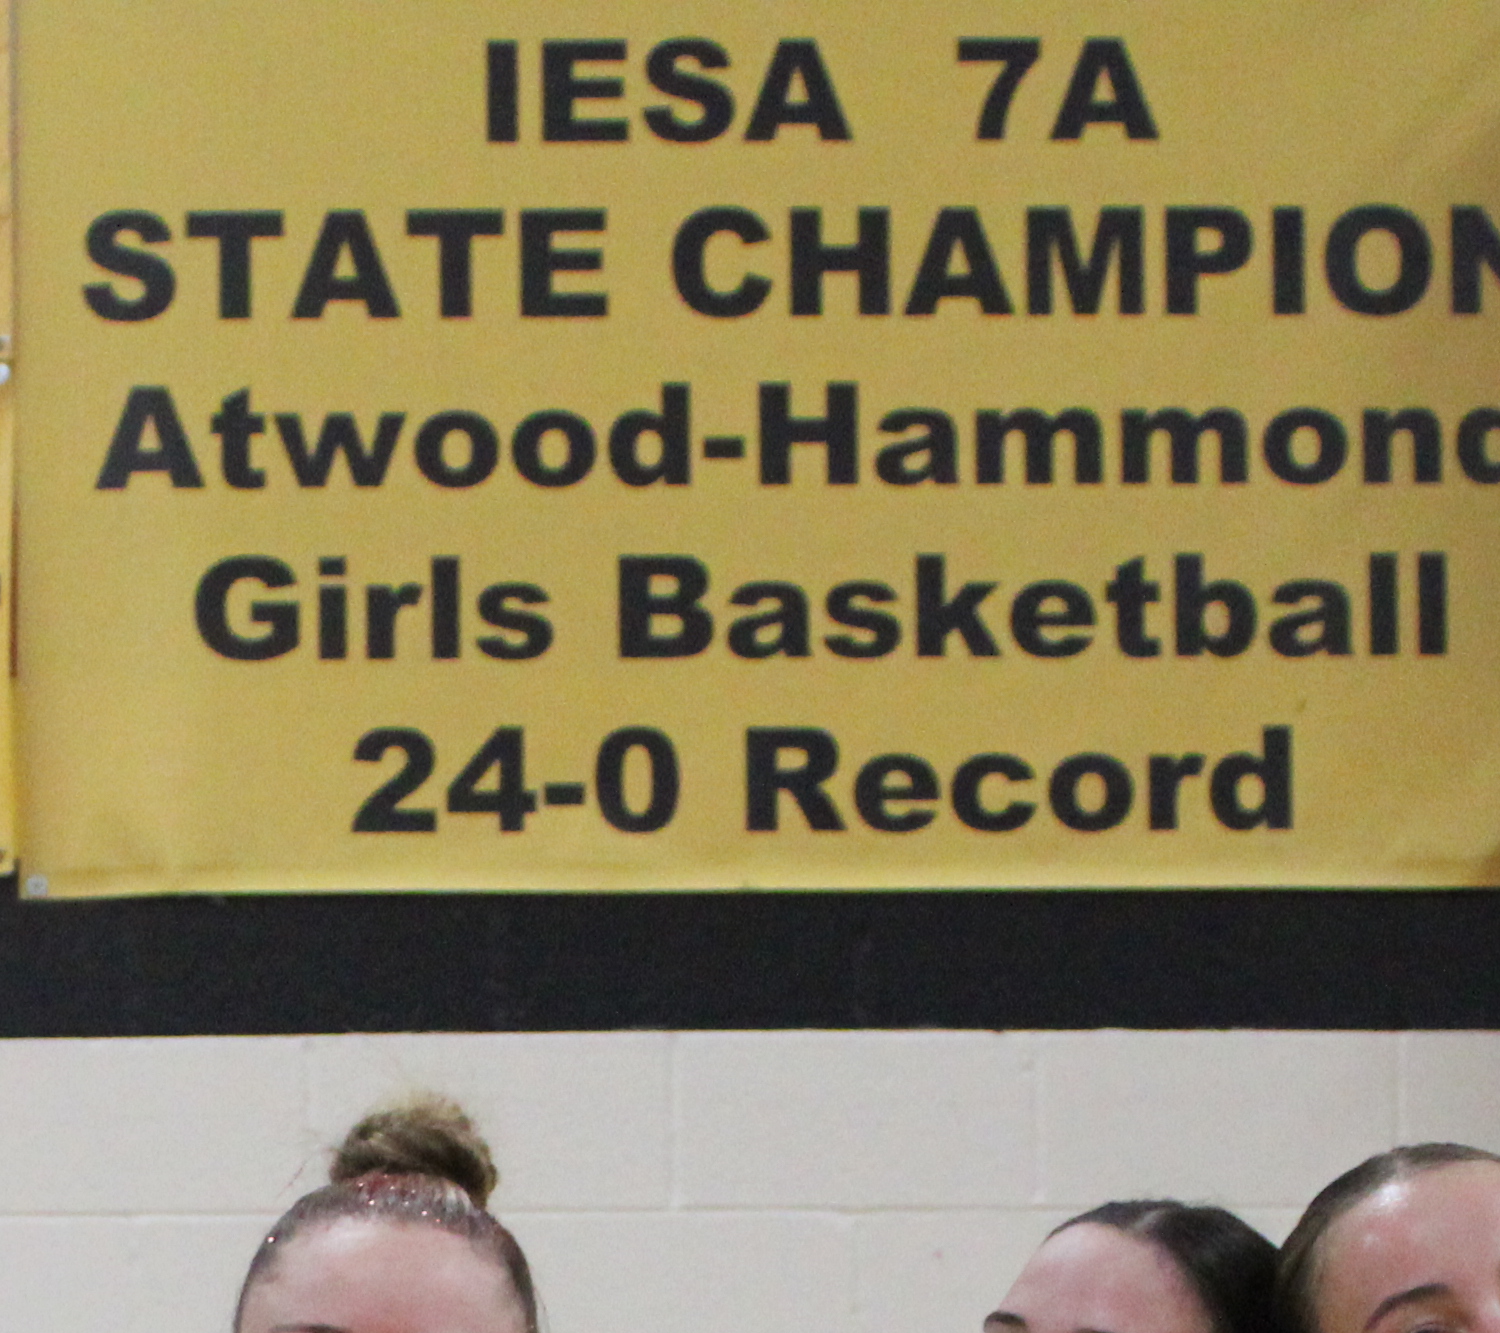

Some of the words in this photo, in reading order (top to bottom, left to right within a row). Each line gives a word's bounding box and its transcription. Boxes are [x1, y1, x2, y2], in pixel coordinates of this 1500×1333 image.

[486, 37, 853, 143] IESA
[957, 37, 1160, 141] 7A
[83, 208, 609, 322] STATE
[194, 555, 554, 661] Girls
[618, 550, 1449, 660] Basketball
[352, 726, 680, 833] 24-0
[745, 724, 1293, 833] Record
